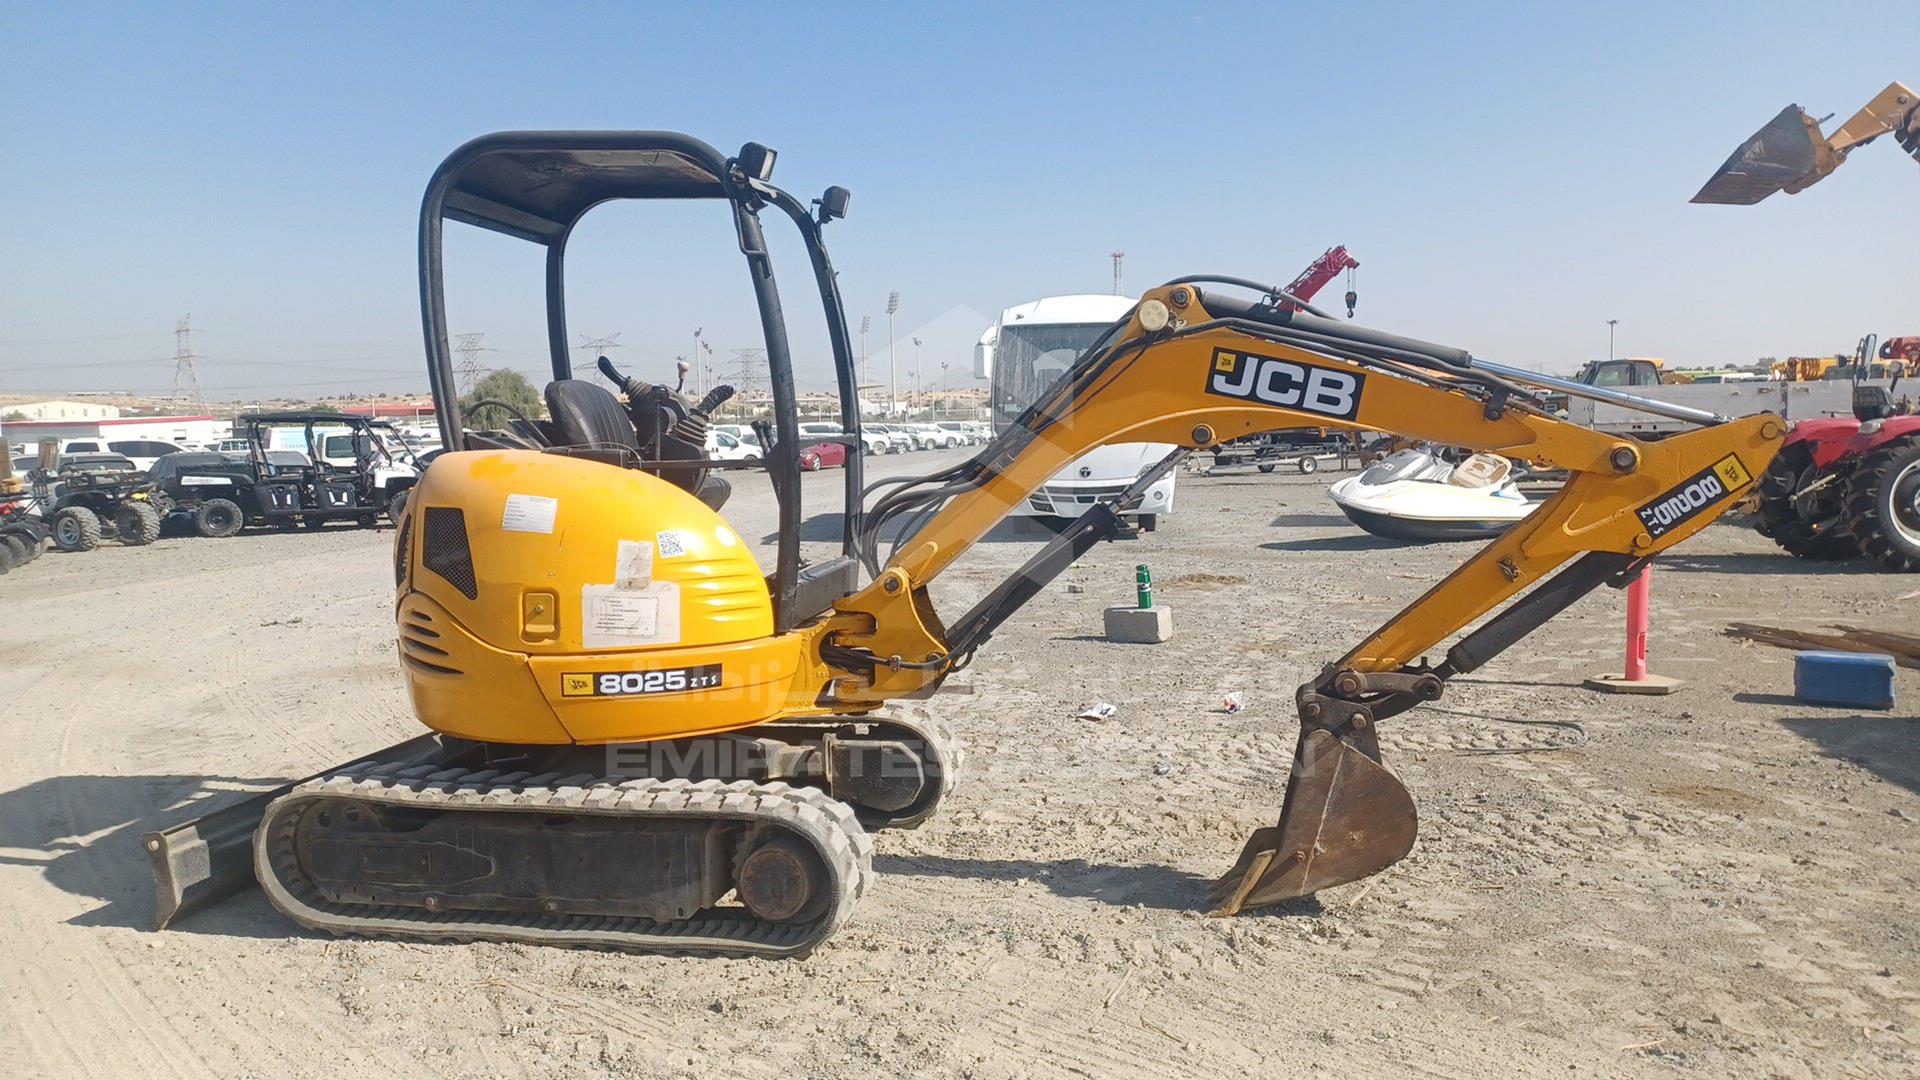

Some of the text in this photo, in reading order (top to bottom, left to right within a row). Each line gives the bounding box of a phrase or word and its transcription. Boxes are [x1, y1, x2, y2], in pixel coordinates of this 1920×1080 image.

[1213, 356, 1356, 416] JCB
[1654, 475, 1722, 525] 8025
[599, 670, 686, 694] 8025
